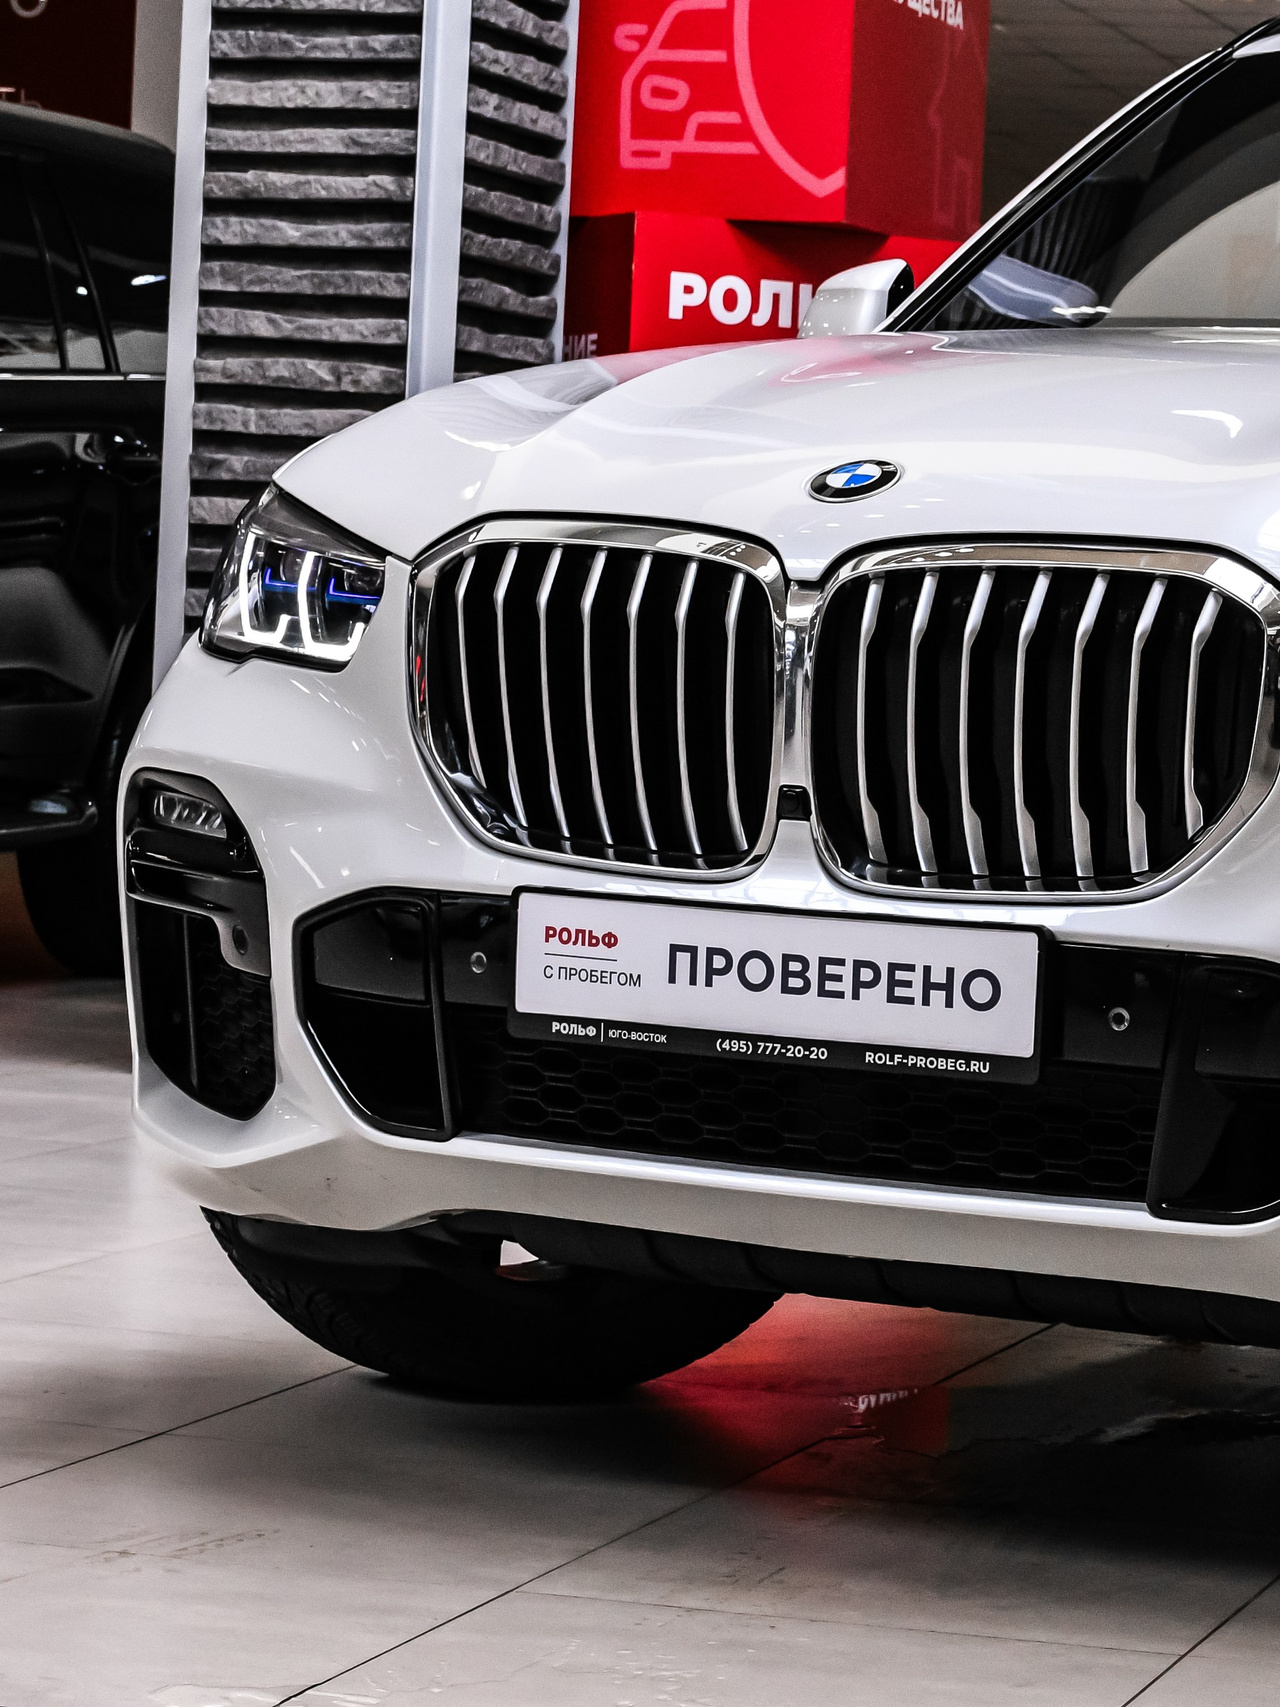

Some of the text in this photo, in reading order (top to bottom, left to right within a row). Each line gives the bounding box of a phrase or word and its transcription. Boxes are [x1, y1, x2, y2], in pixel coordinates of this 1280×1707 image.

[544, 925, 619, 949] РОЛЬФ
[543, 964, 641, 988] С ПРОБЕГОМ
[667, 943, 1002, 1012] ПРОВЕРЕНО
[551, 1021, 667, 1044] РОЛЬФ ЮГО-ВОСТОК
[716, 1038, 828, 1060] (495) 777-20-20
[865, 1051, 990, 1074] ROLF-PROBEG.RU
